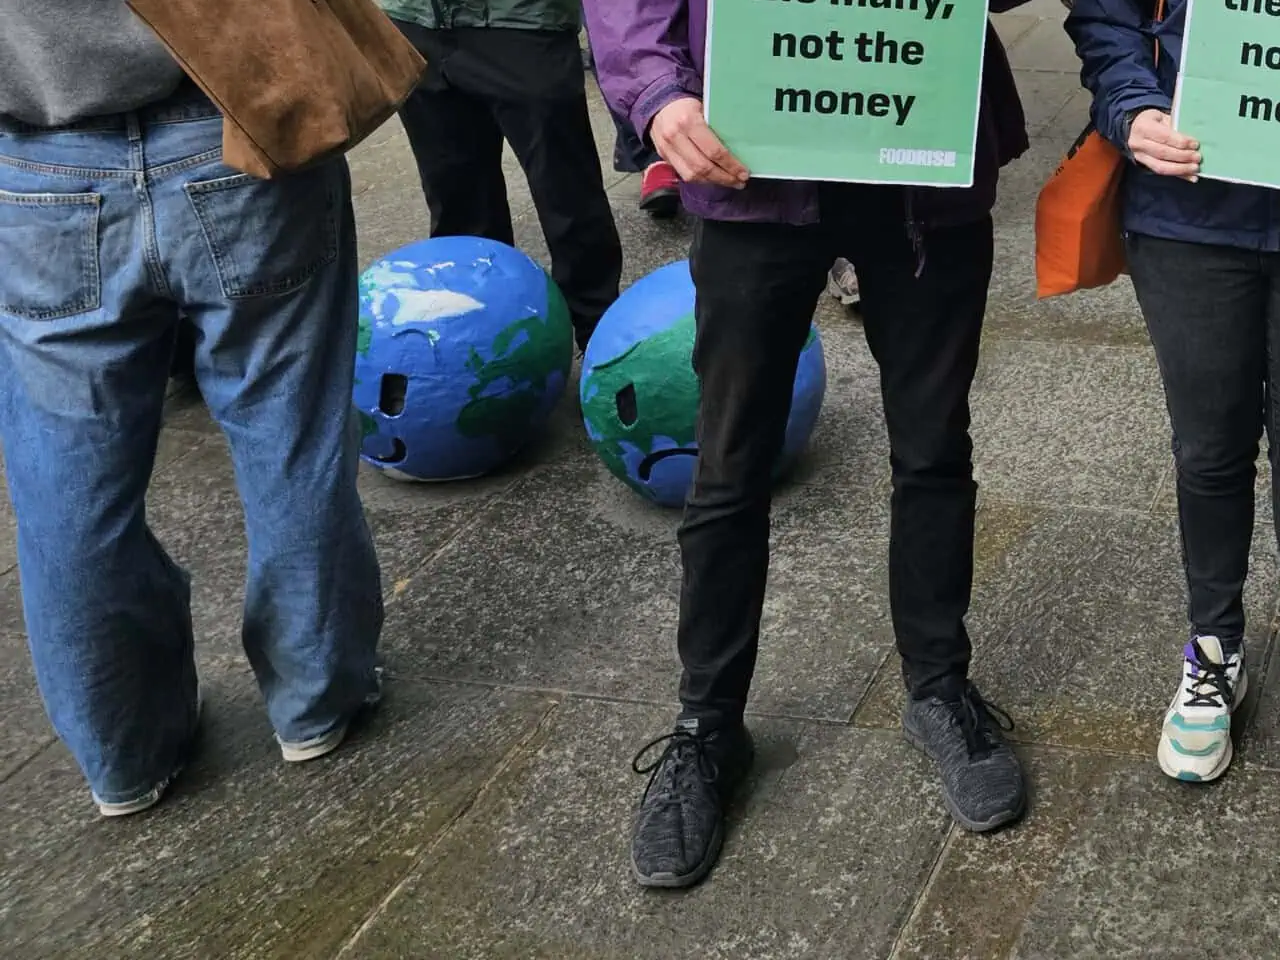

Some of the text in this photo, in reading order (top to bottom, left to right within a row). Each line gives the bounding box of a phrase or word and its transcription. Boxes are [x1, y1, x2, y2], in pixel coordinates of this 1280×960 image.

[772, 30, 925, 66] not the
[774, 87, 916, 126] money
[879, 147, 957, 168] FOODRISE
